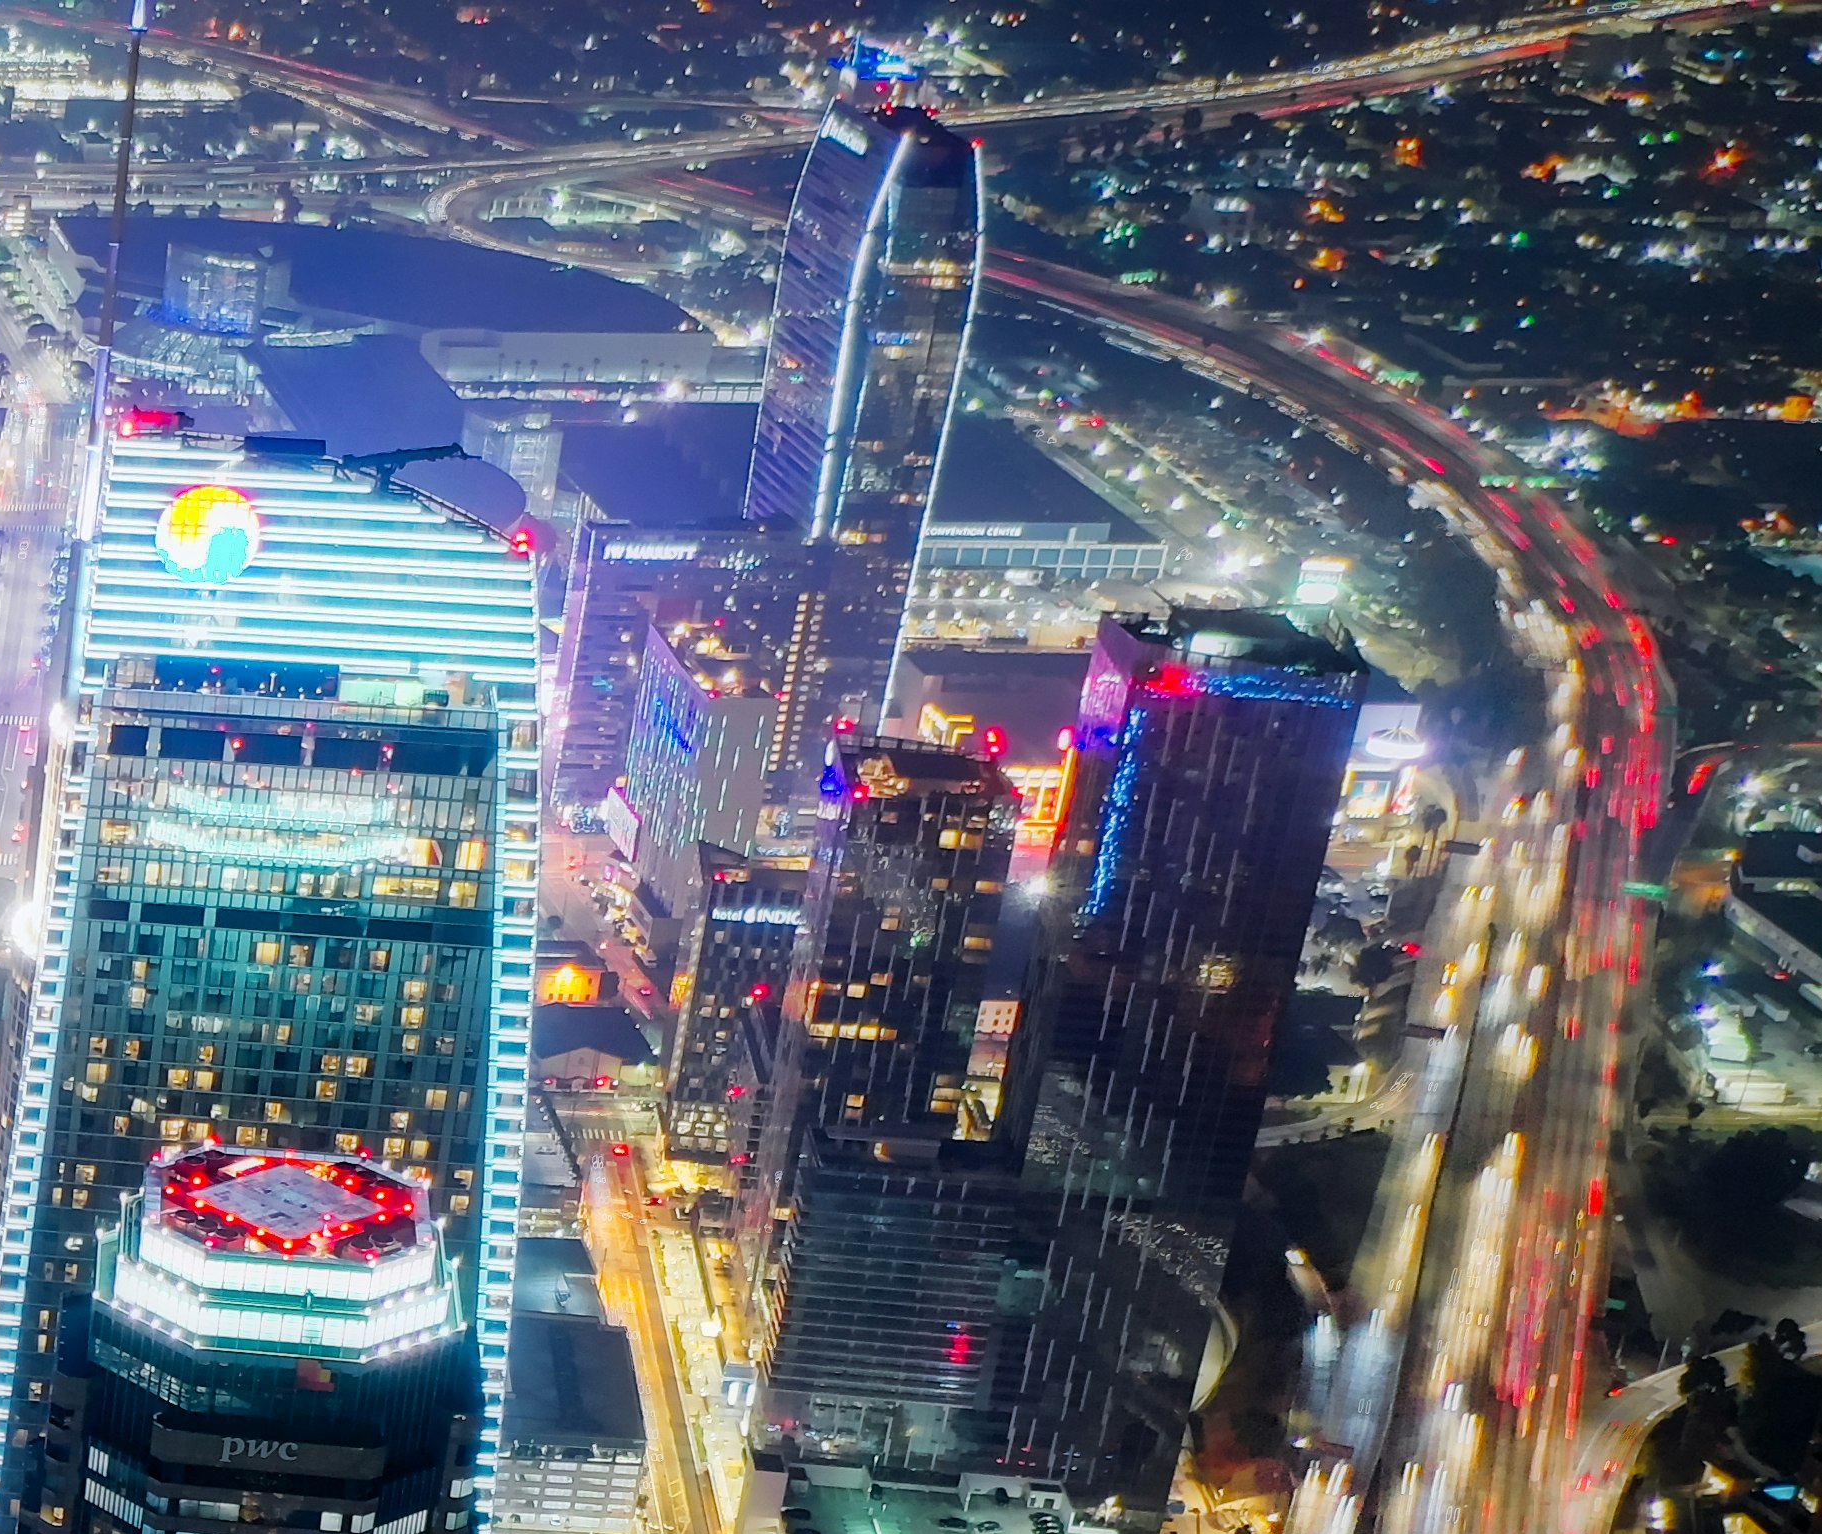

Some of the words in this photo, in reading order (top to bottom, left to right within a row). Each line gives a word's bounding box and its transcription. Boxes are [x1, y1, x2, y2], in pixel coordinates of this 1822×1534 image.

[925, 526, 986, 538] CONVENTION
[711, 907, 742, 922] hotel
[756, 907, 803, 926] INDIG
[220, 1436, 299, 1463] pwc
